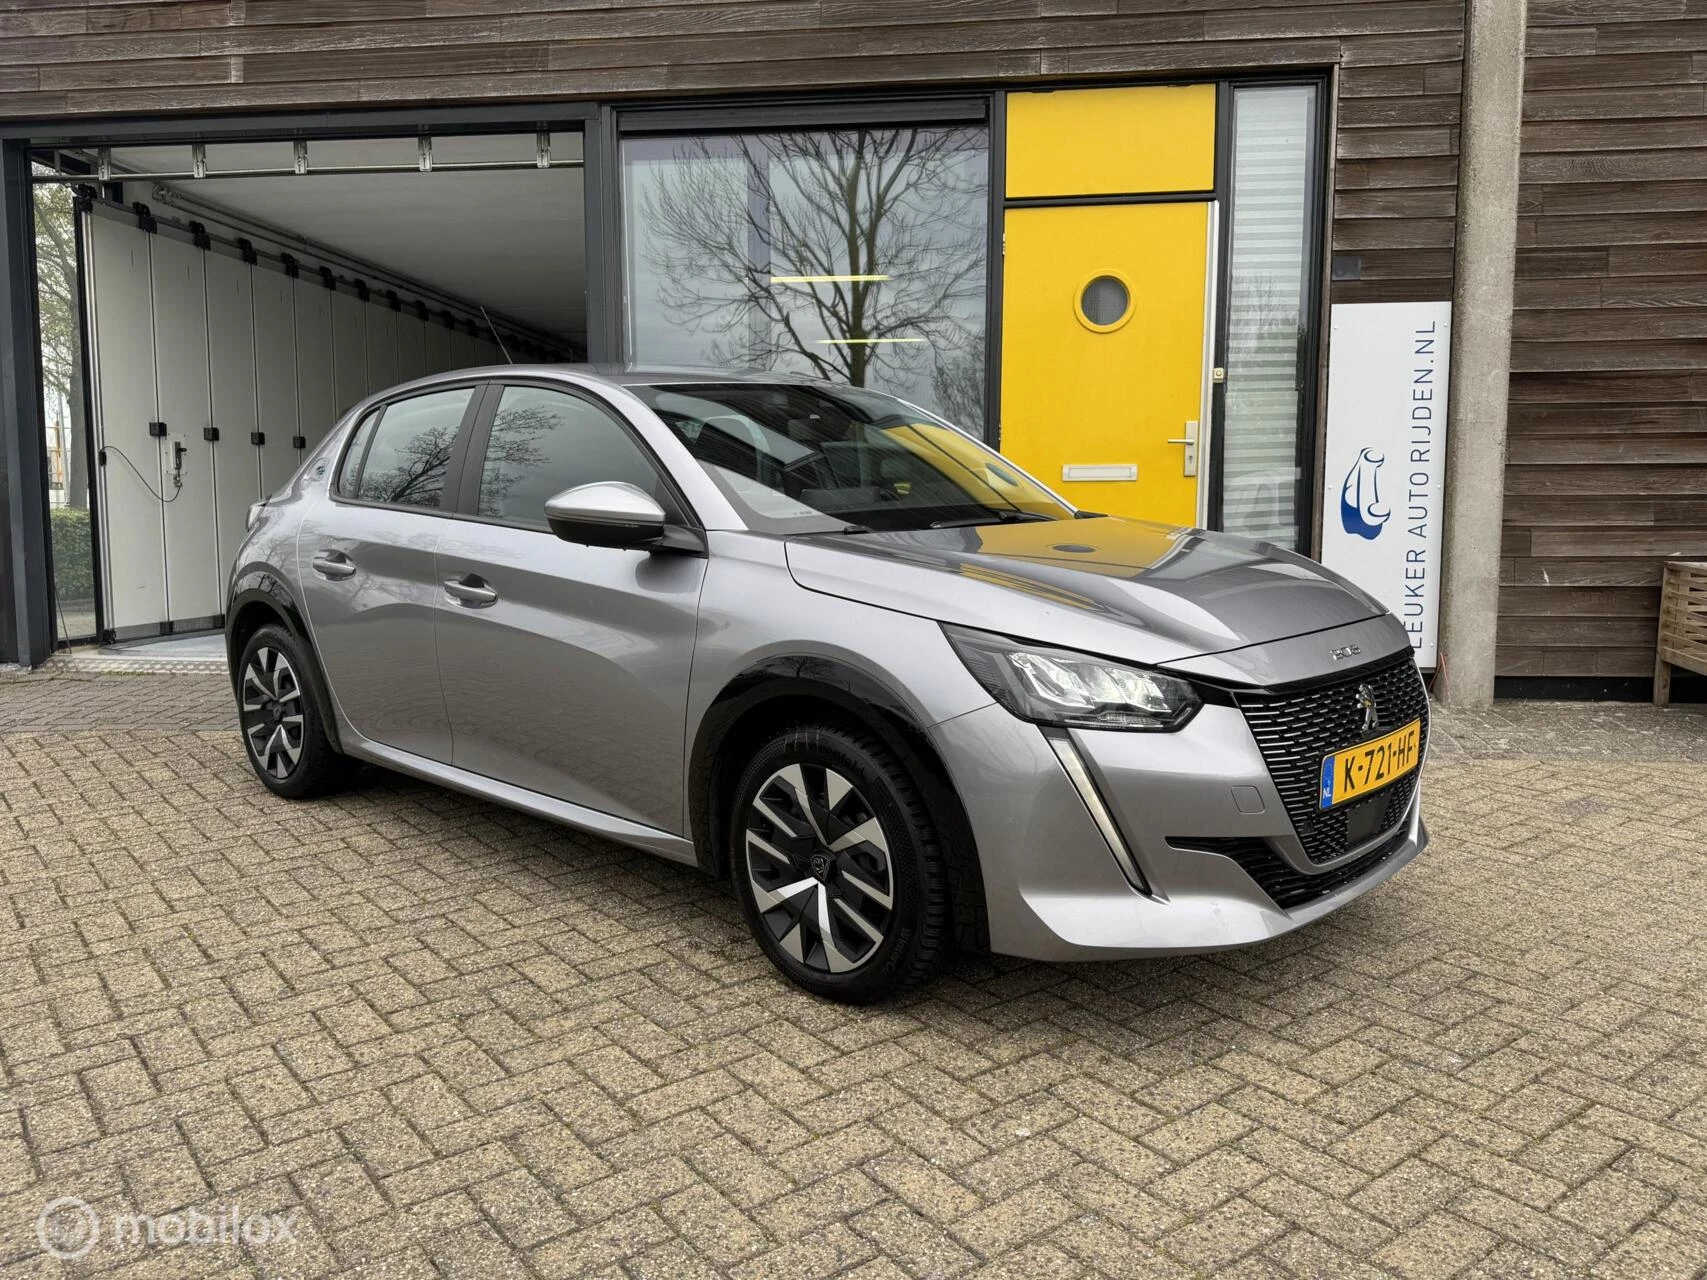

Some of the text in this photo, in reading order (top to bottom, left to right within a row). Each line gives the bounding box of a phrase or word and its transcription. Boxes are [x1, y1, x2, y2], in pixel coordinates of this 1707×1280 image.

[1403, 320, 1436, 650] LEUKER AUTO RIJDEN.NL
[1343, 730, 1415, 792] K-721-HF
[1322, 787, 1332, 799] NL
